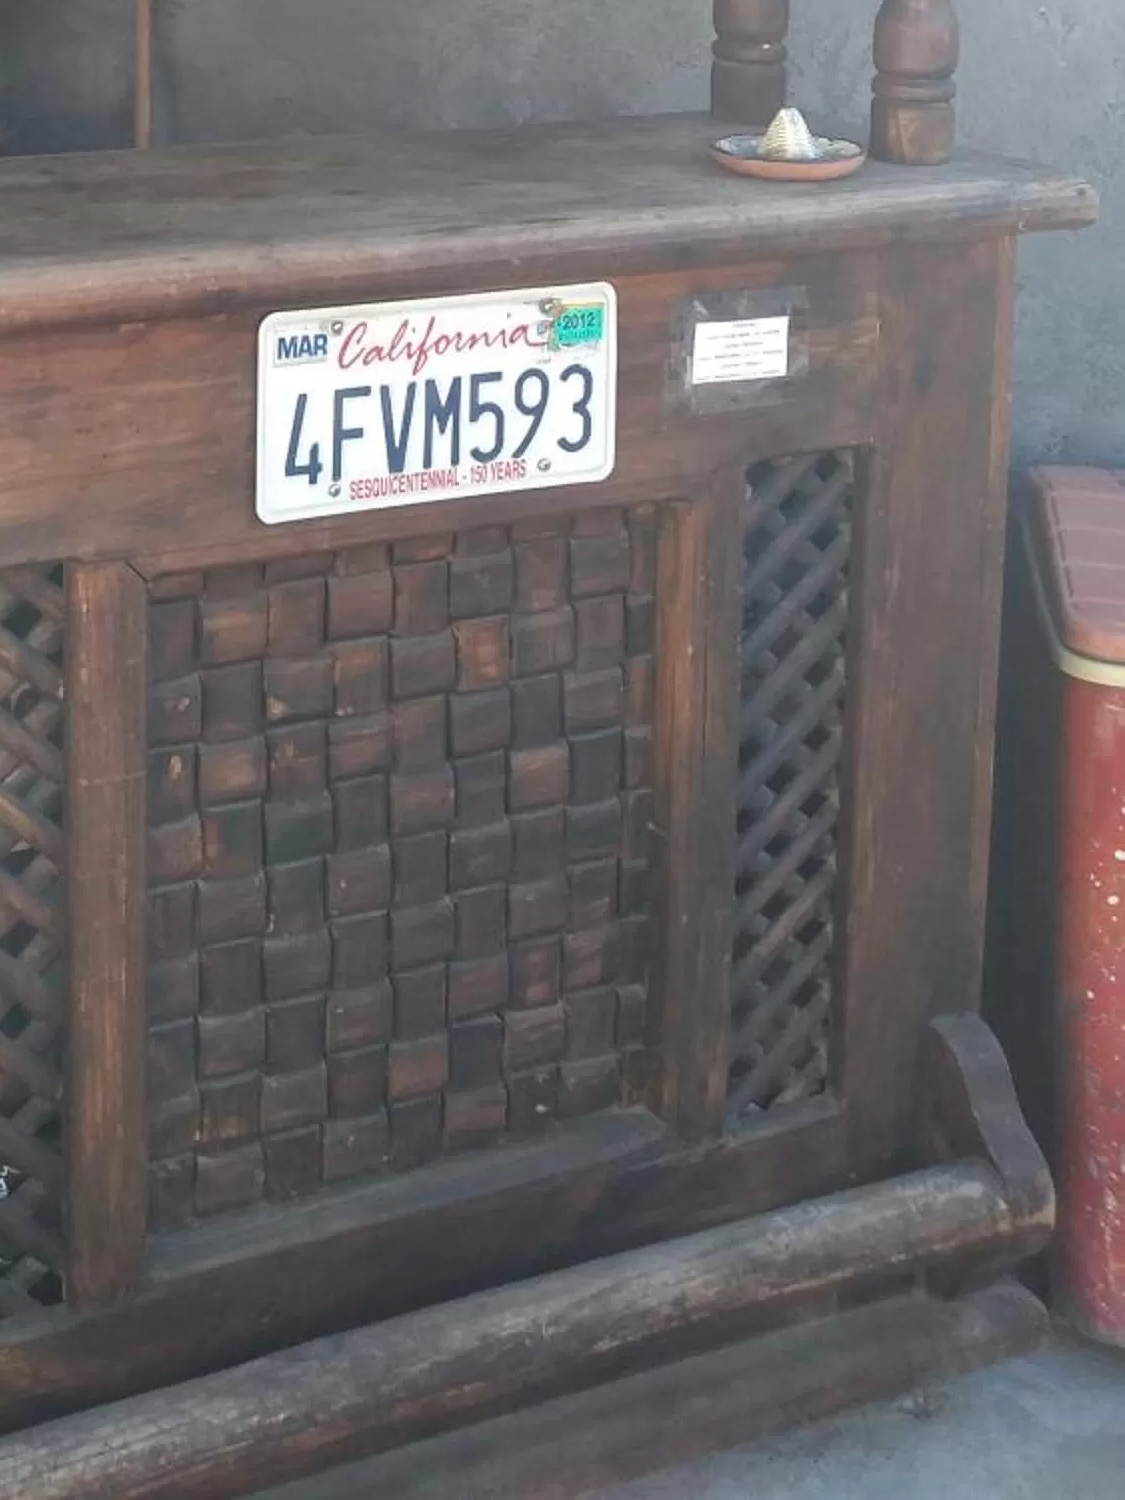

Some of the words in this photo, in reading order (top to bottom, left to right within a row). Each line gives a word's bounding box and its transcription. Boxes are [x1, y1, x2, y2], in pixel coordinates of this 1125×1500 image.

[562, 311, 596, 330] 2012
[276, 333, 328, 360] MAR
[337, 315, 545, 375] California
[284, 363, 594, 485] 4FVM593
[348, 467, 460, 500] SESQUICENTENNIAL
[469, 463, 489, 485] 150
[489, 459, 528, 481] YEARS
